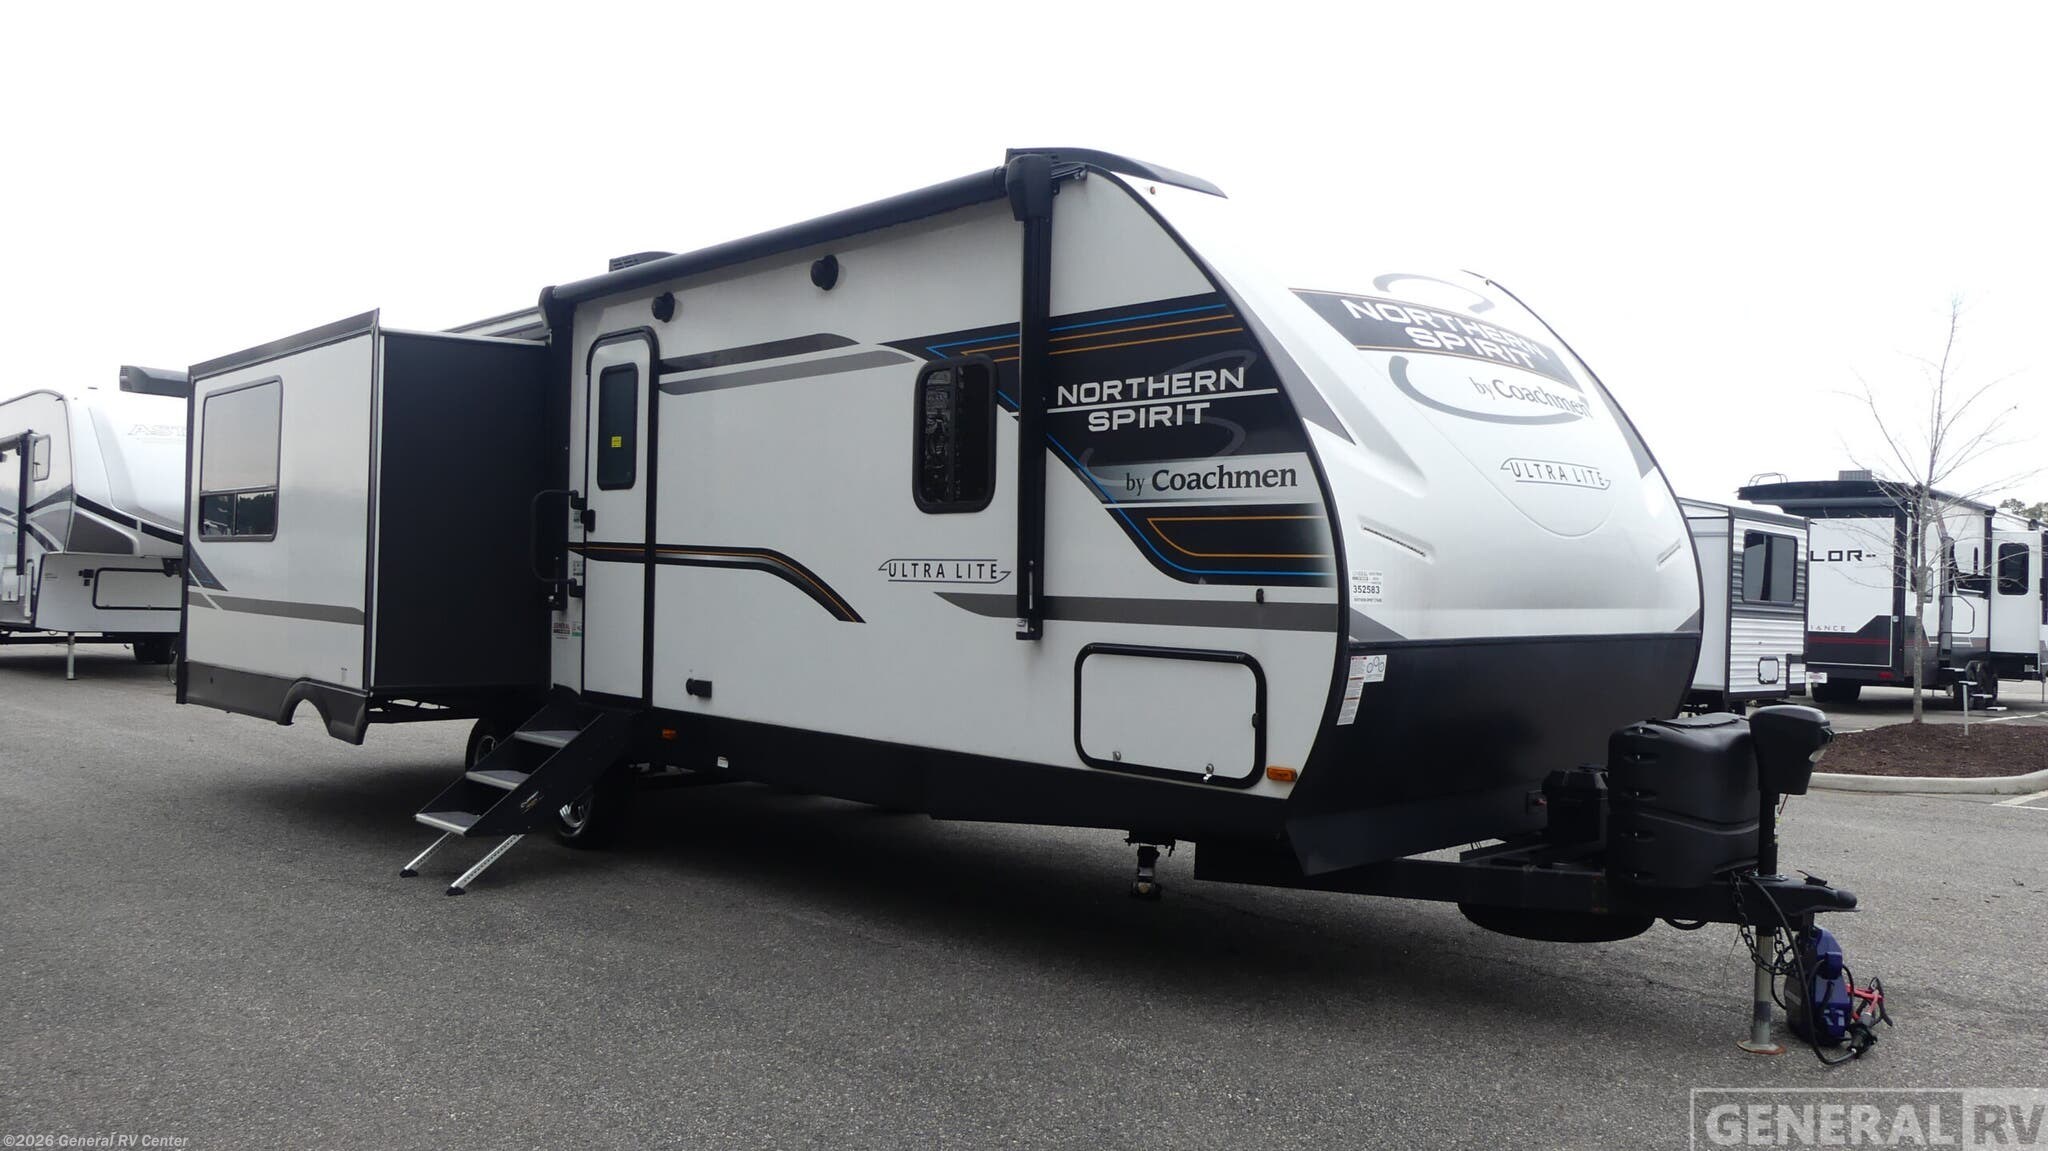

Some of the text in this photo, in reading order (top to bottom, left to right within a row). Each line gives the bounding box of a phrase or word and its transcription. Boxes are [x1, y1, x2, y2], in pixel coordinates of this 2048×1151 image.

[1340, 299, 1550, 361] NORTHERN
[1404, 326, 1536, 369] SPIRIT
[1057, 366, 1245, 406] NORTHERN
[1468, 376, 1594, 420] by Coachmen
[1087, 402, 1211, 432] SPIRIT
[1125, 464, 1298, 497] by Coachmen
[1509, 461, 1606, 487] ULTRA LITE
[888, 562, 998, 580] ULTRA LITE
[1352, 584, 1381, 594] 352583
